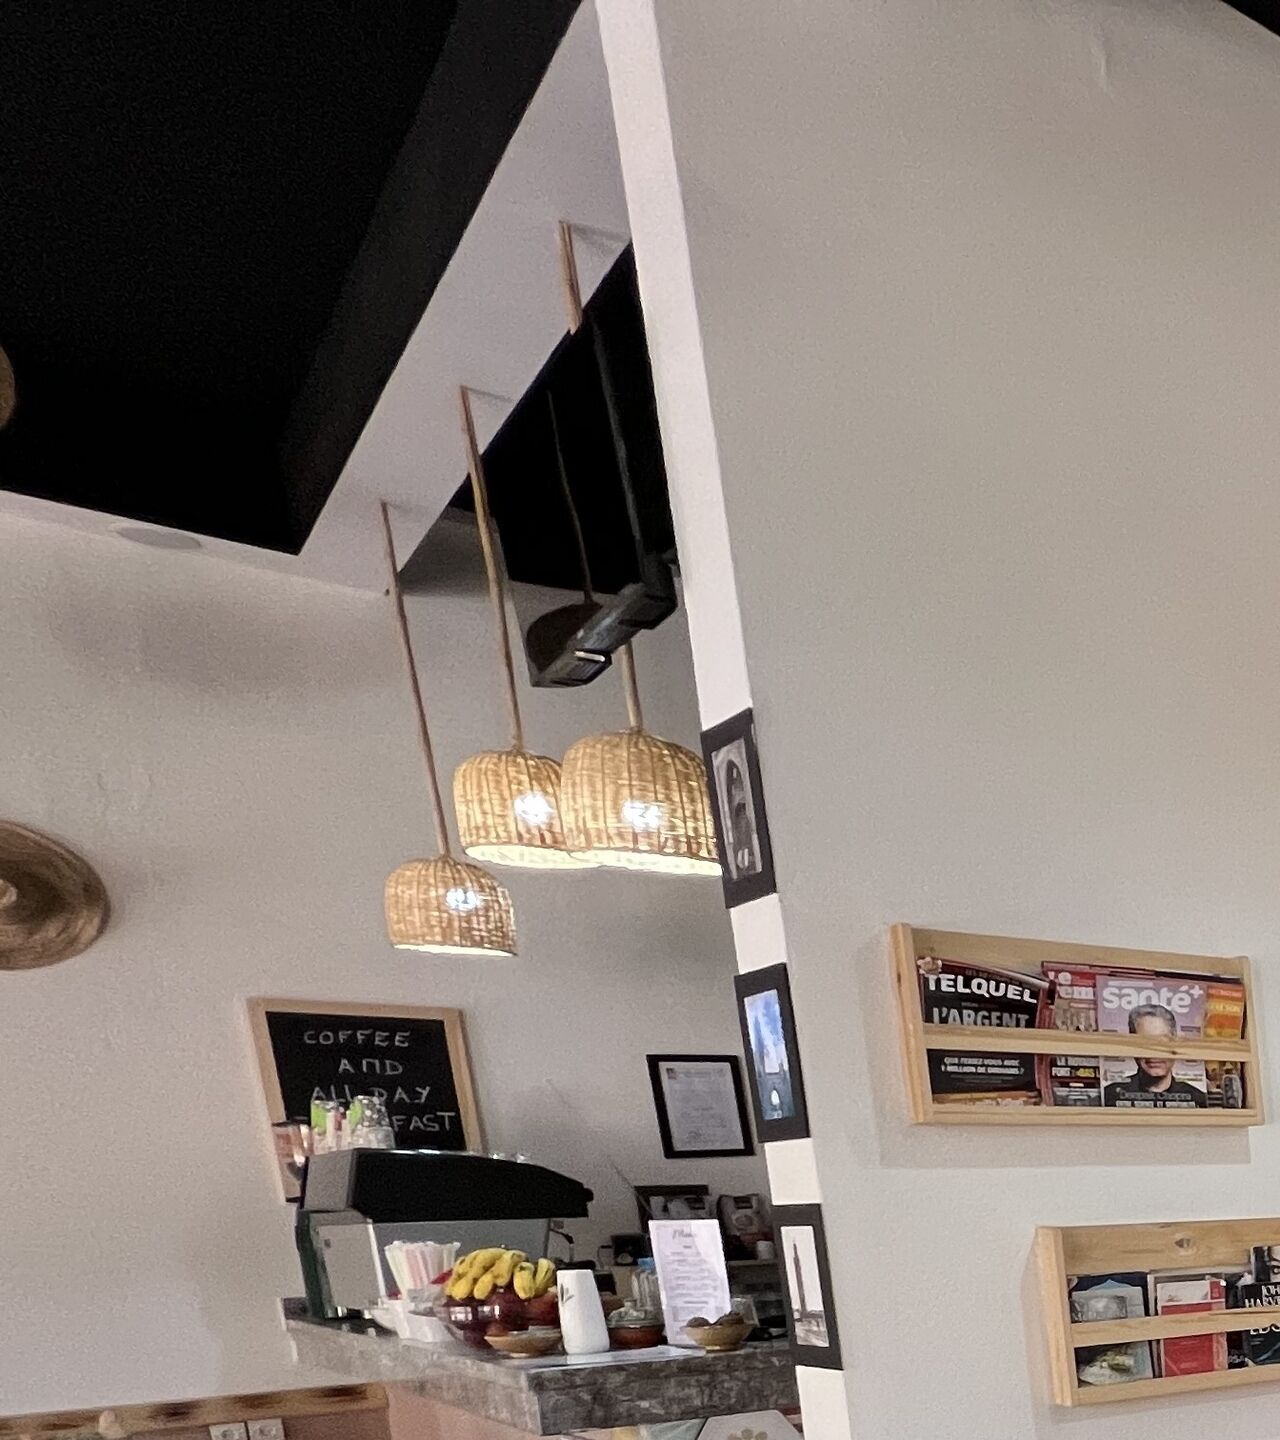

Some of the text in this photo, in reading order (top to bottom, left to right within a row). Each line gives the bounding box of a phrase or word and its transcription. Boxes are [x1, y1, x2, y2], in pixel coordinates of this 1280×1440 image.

[925, 974, 1038, 1004] TELQUEL
[304, 1029, 411, 1047] COFFEE
[338, 1057, 403, 1075] AND
[368, 1086, 431, 1103] DAY
